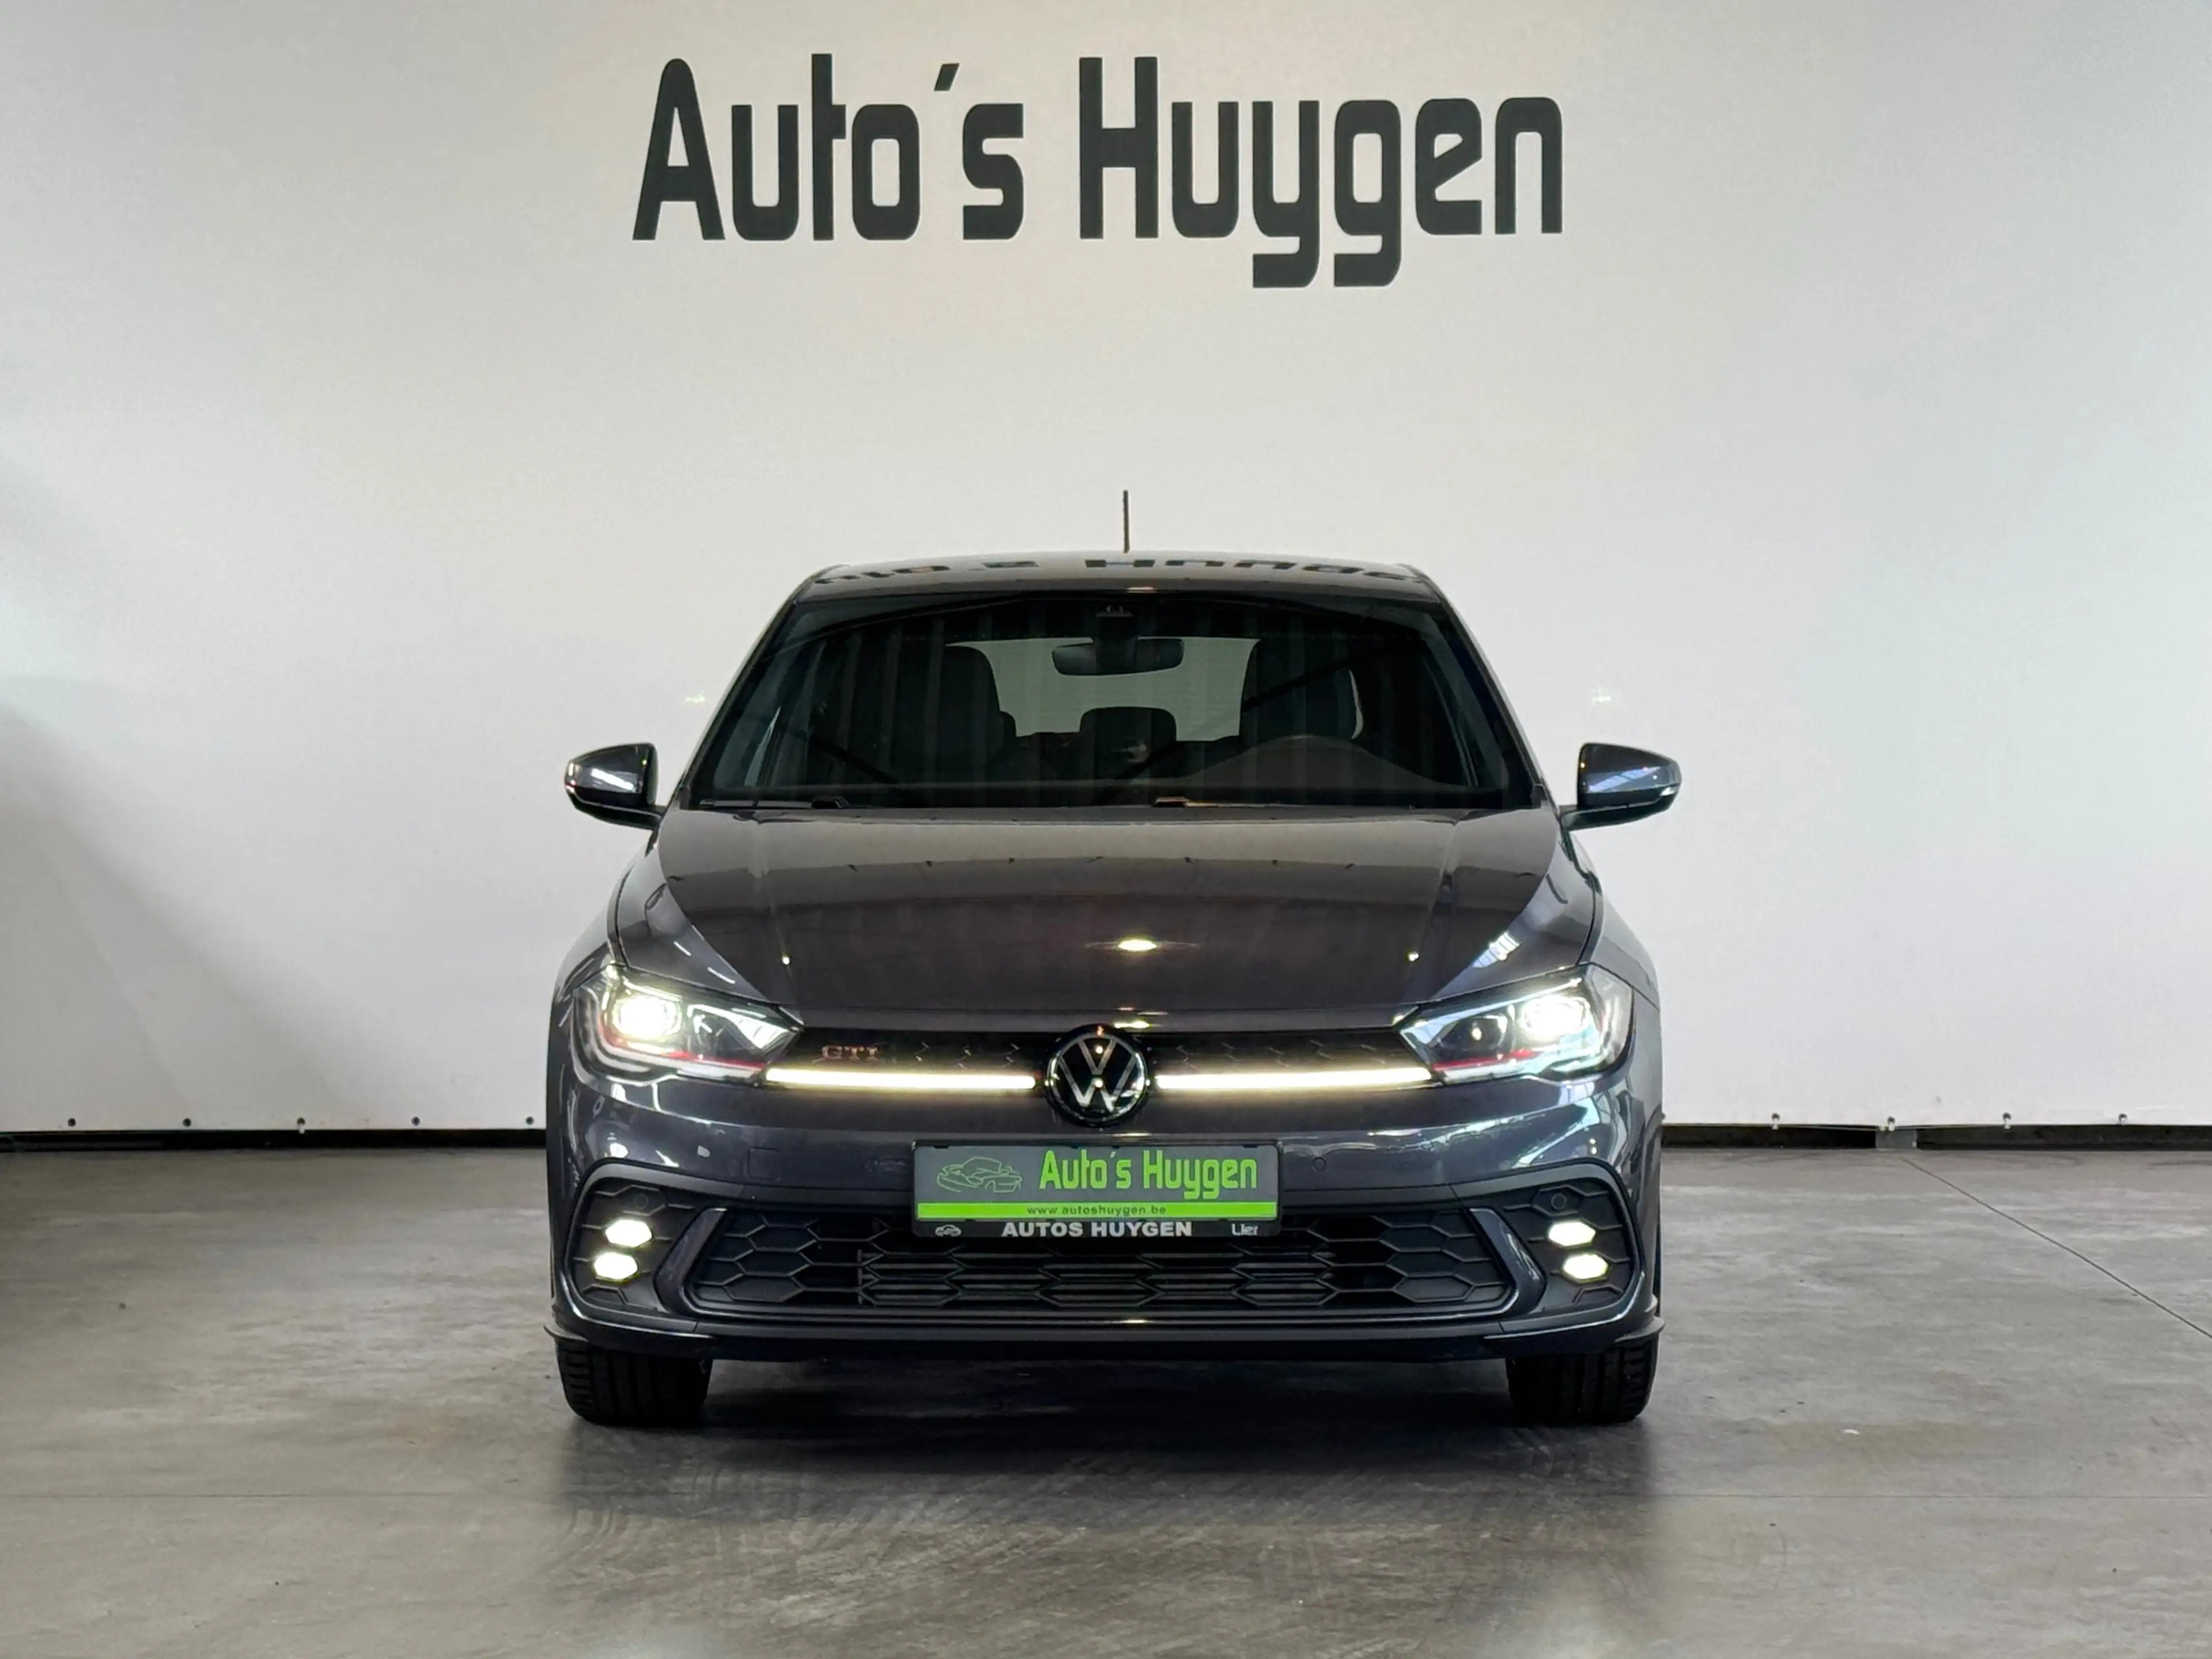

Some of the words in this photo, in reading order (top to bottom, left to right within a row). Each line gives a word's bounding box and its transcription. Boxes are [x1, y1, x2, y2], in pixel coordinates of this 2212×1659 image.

[1079, 56, 1563, 289] Huygen
[822, 1044, 879, 1061] GTI
[1143, 1150, 1257, 1200] Huygen
[1026, 1205, 1167, 1217] www.autoshuygen.be
[1001, 1222, 1084, 1237] AUTOS
[1091, 1221, 1192, 1237] HUYGEN
[1231, 1223, 1258, 1236] Lier
